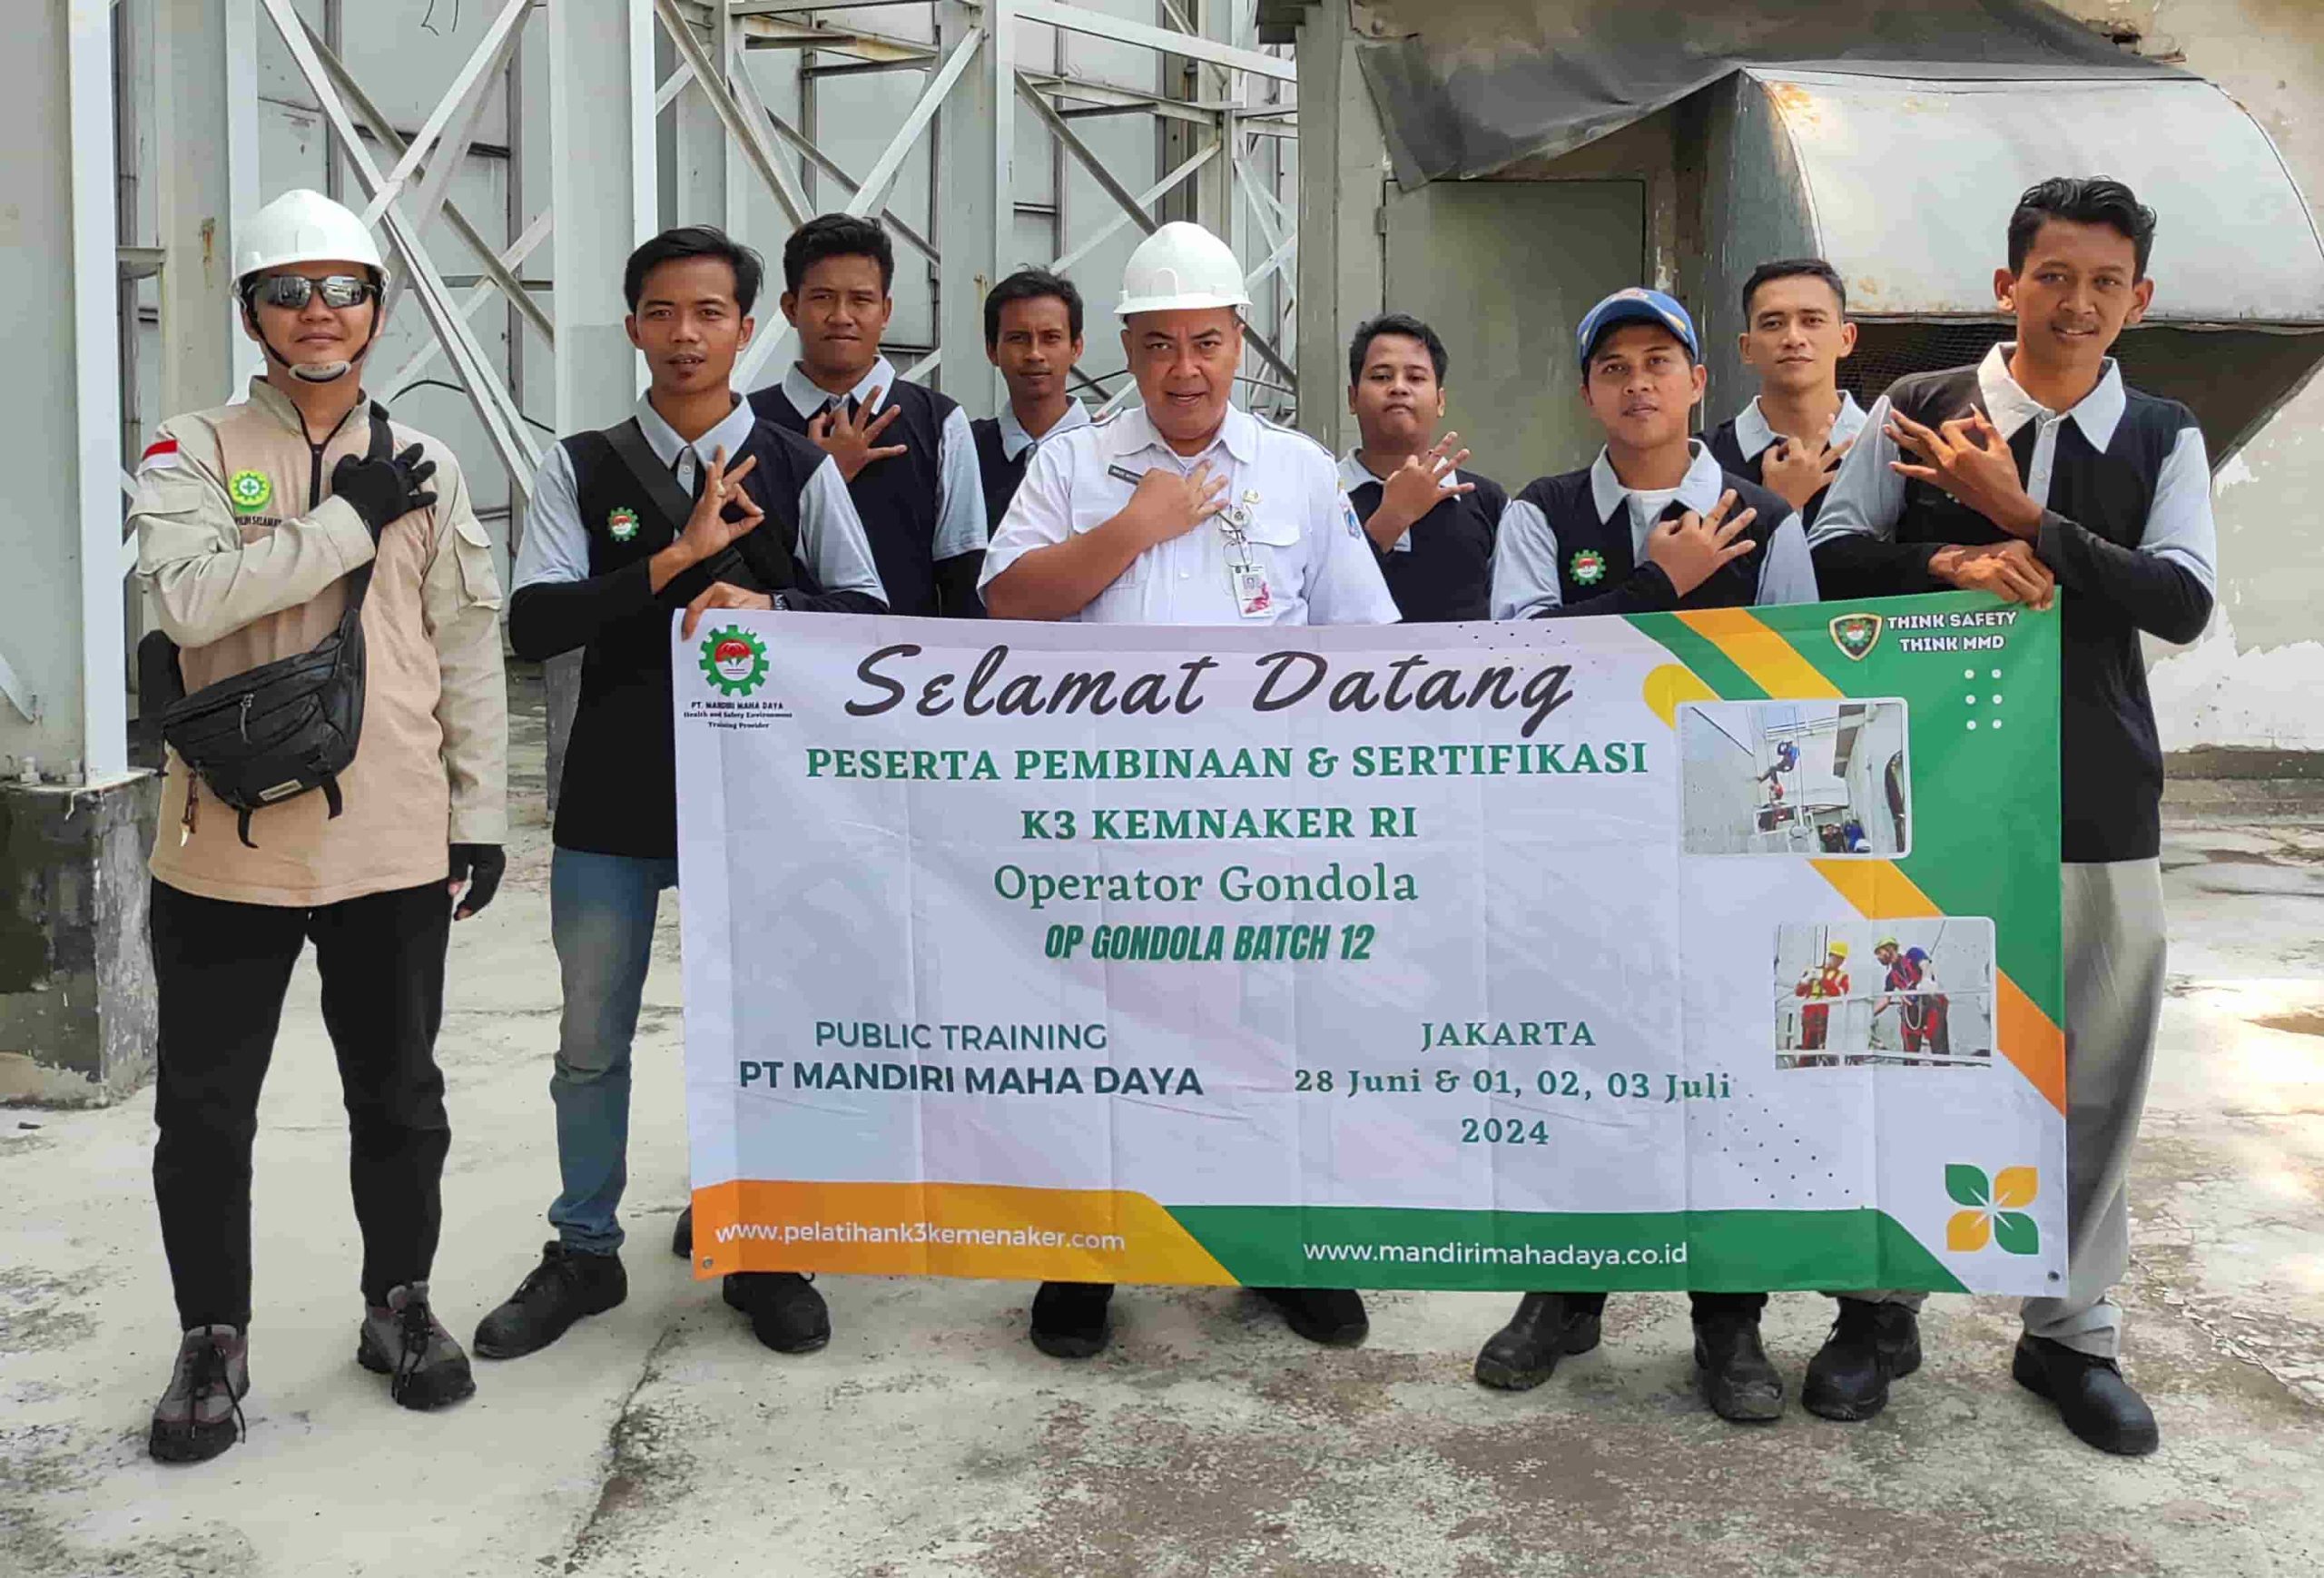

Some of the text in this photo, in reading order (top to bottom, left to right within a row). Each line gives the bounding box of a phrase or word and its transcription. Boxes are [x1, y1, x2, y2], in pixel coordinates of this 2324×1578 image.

[1887, 610, 2018, 630] THINK SAFETY
[1898, 635, 2006, 653] THINK MMD
[737, 701, 761, 710] MAHA
[763, 701, 784, 710] DAYA
[844, 644, 1573, 738] Selamat Datang
[806, 743, 1649, 781] PESERTA PEMBINAAN & SERTIFIKASI
[1020, 807, 1418, 841] K3 KEMNAKER RI
[994, 863, 1419, 909] Operator Gondola
[1045, 924, 1375, 962] OP GONDOLA BATCH 12
[815, 1021, 1108, 1050] PUBLIC TRAINING
[1421, 1021, 1597, 1053] JAKARTA
[739, 1060, 1204, 1096] PT MANDIRI MAHA DAYA
[1295, 1068, 1730, 1104] 28 Juni & 01, 02, 03 Juli
[1462, 1118, 1550, 1146] 2024
[714, 1221, 1126, 1251] www.pelatihank3kemenaker.com
[1303, 1240, 1689, 1270] www.mandirimahadaya.co.id
